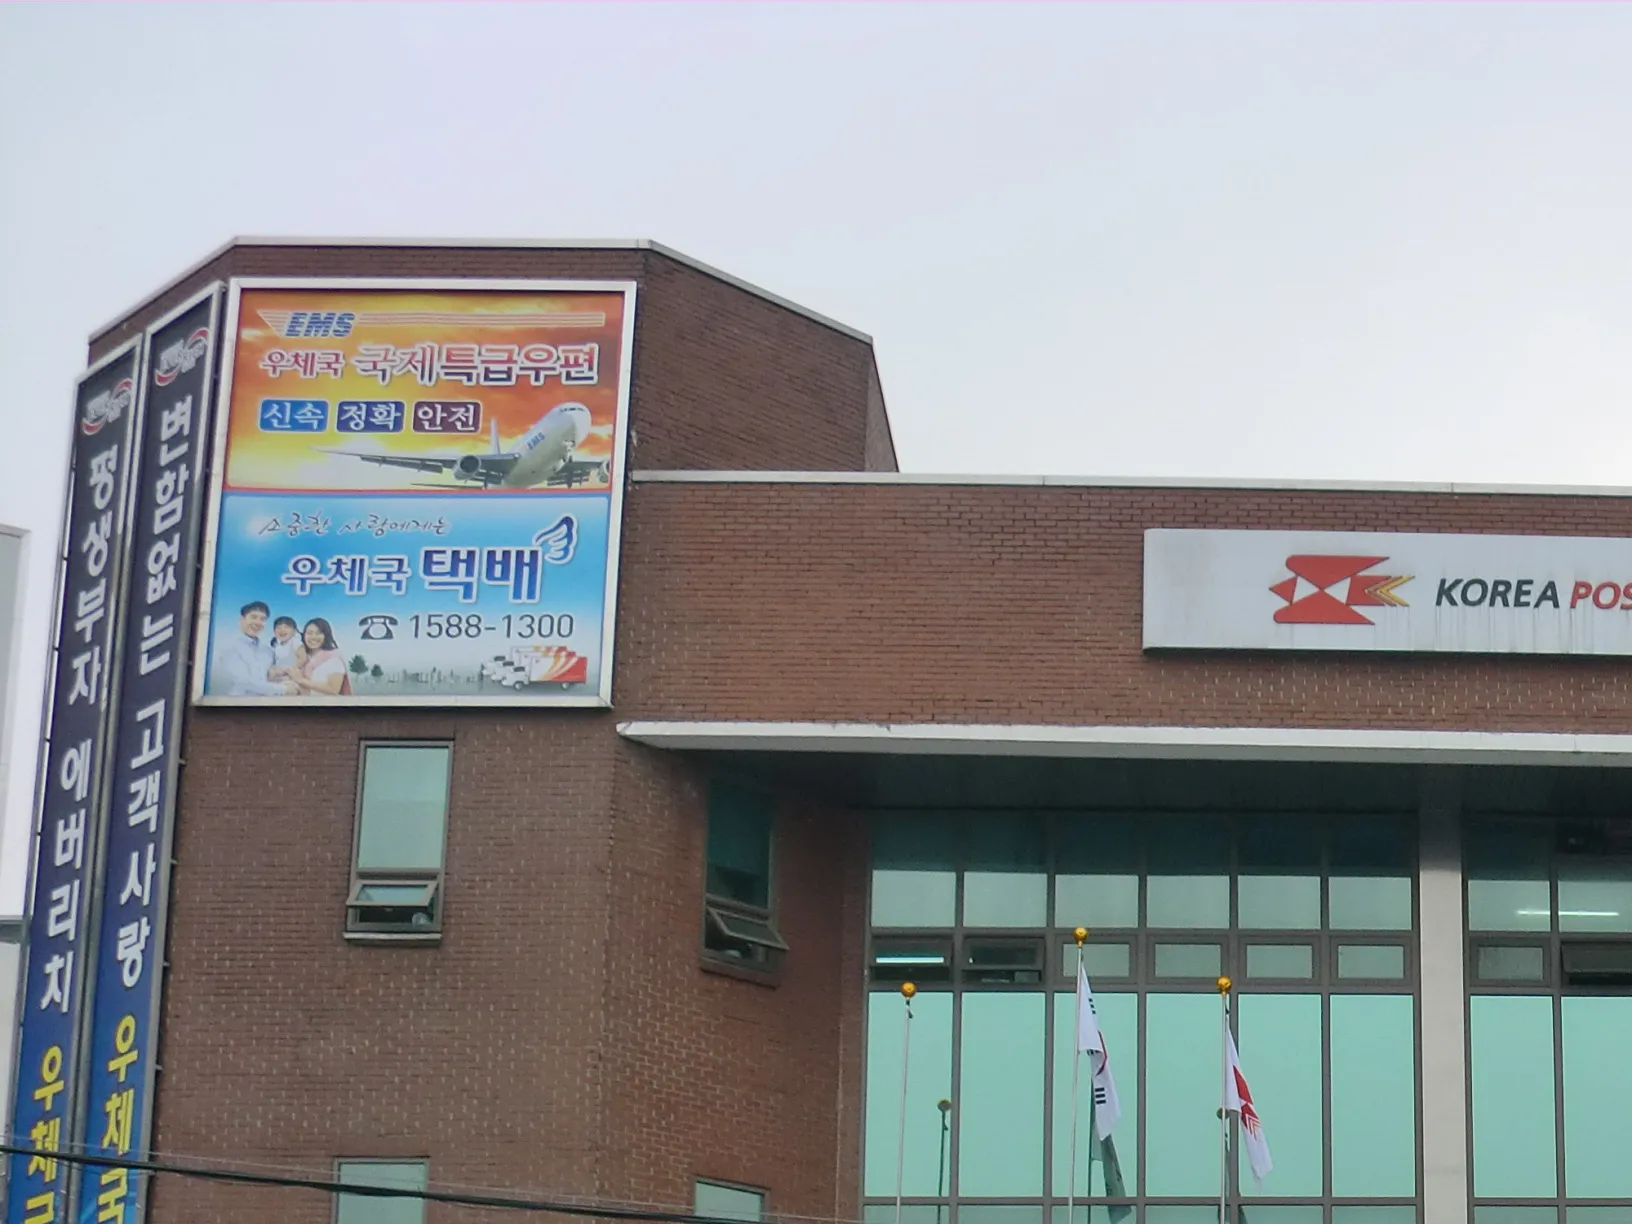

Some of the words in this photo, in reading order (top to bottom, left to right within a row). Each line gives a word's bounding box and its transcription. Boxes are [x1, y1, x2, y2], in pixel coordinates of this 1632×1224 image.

[284, 311, 356, 337] EMS
[259, 350, 345, 378] 우체국
[353, 342, 600, 387] 국제특급우편
[263, 401, 326, 431] 신속
[340, 402, 401, 432] 정확
[416, 404, 478, 432] 안전
[141, 394, 193, 676] 변함없는
[69, 444, 118, 706] 평생부자
[280, 554, 412, 595] 우체국
[419, 549, 542, 603] 택배
[1434, 576, 1561, 610] KOREA
[409, 614, 575, 640] 1588-1300
[40, 737, 92, 1013] 에버리치
